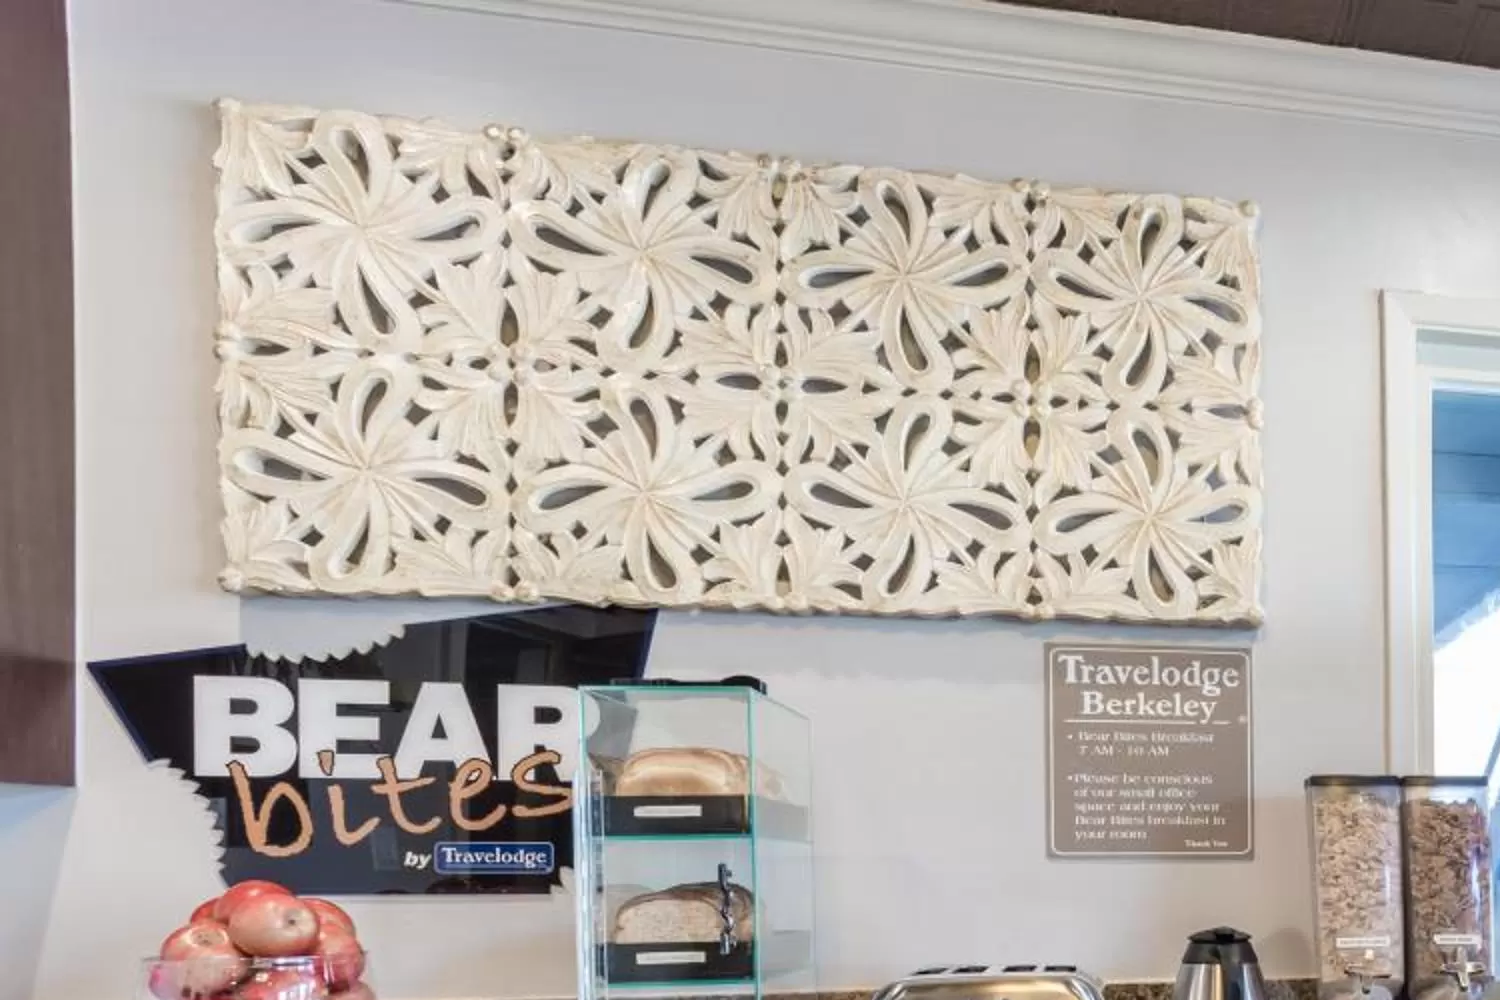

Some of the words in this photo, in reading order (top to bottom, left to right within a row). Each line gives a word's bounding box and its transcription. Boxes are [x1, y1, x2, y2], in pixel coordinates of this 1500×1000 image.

[1057, 654, 1240, 697] Travelodge
[1081, 690, 1218, 725] Berkeley
[193, 674, 600, 781] BEAR
[1093, 745, 1114, 756] AM
[1148, 745, 1169, 756] AM
[1074, 773, 1118, 784] Please
[1123, 773, 1141, 784] be
[225, 748, 575, 857] bites
[403, 851, 432, 870] by
[442, 847, 547, 869] Travelodge
